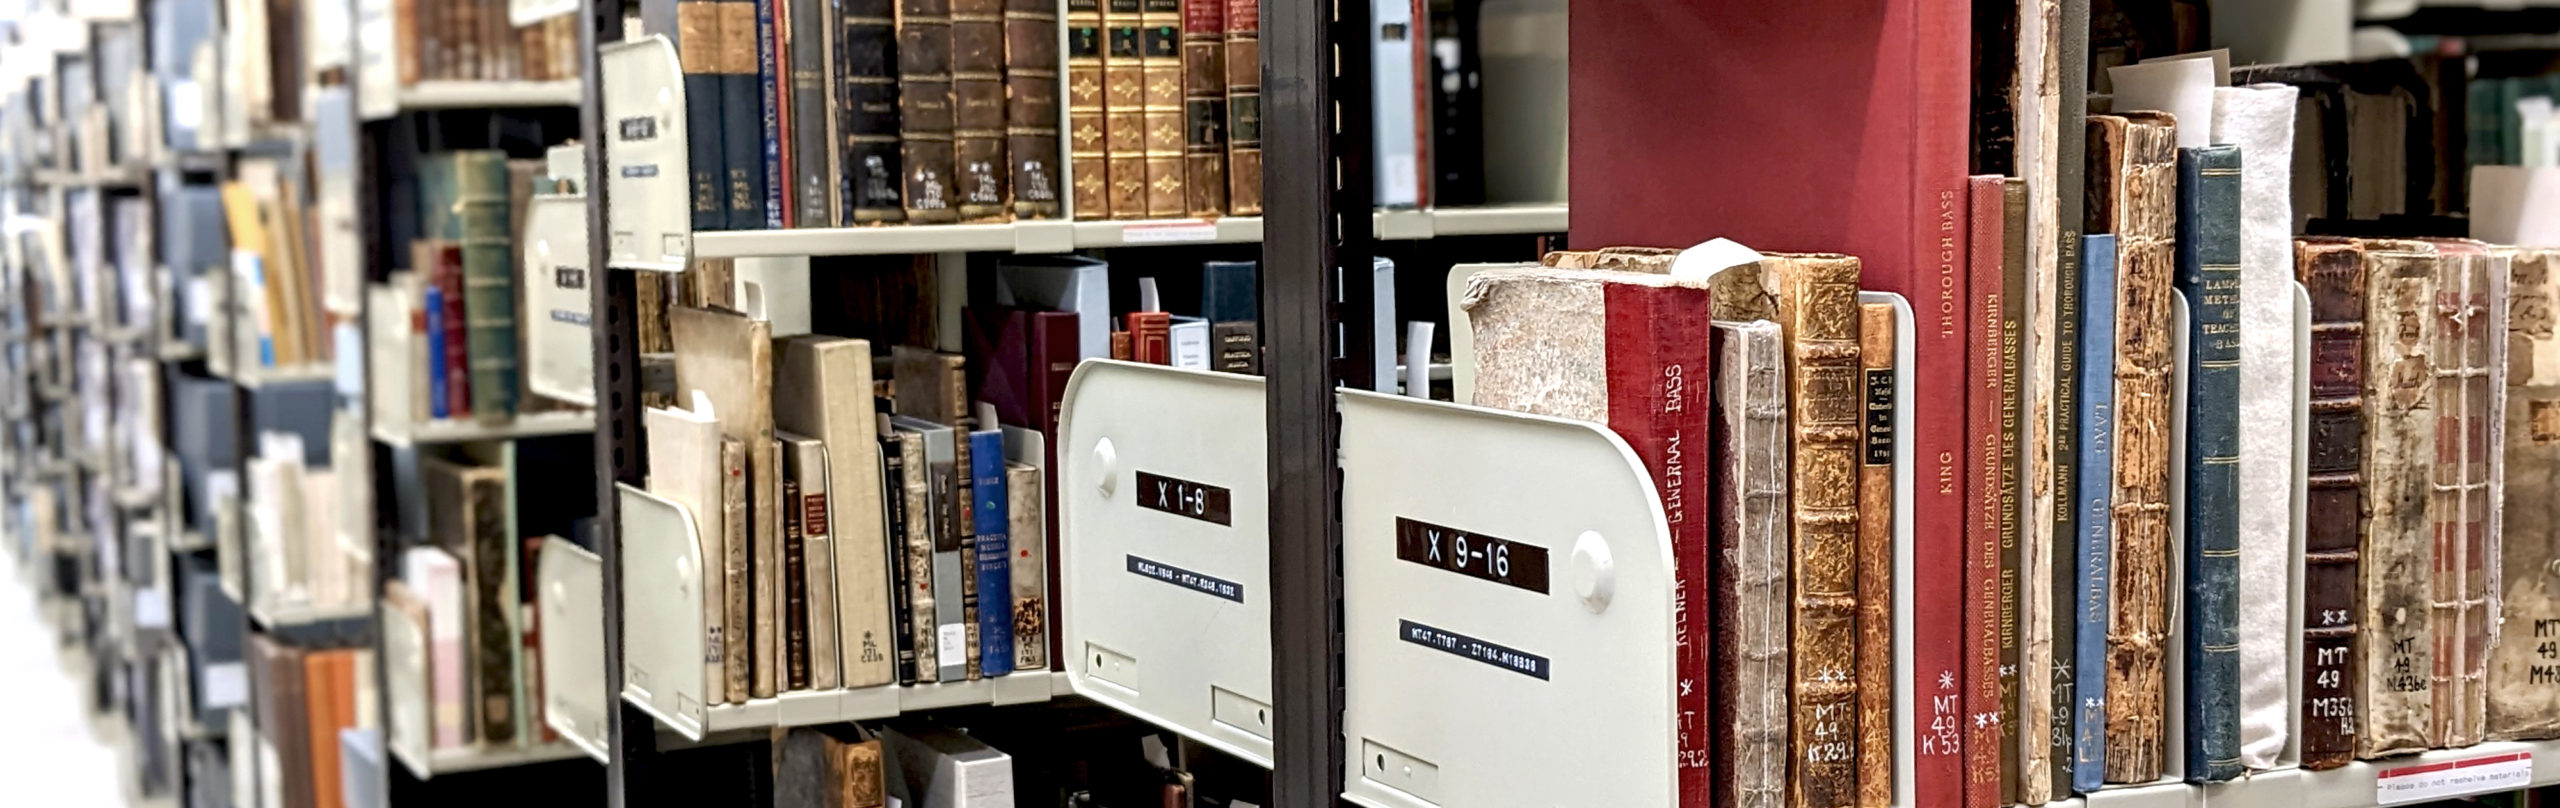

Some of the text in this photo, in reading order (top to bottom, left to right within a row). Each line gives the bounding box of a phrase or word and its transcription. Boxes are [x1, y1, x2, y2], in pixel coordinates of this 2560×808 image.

[1941, 190, 1954, 339] THOROUGH BASS
[2063, 262, 2076, 317] THOROUGH
[1986, 294, 1998, 389] KIRNBERGER
[2062, 321, 2074, 336] TO
[2061, 339, 2073, 371] GUIDE
[1665, 363, 1682, 414] BASS
[2059, 376, 2072, 431] PRACTICAL
[1939, 451, 1953, 496] KING
[2000, 320, 2017, 649] KIRNBERGER GRUNDSÄTZE DES GENERALBASSES
[1157, 480, 1205, 515] X 1-8
[2057, 464, 2069, 522] KOLLMANN
[1428, 529, 1509, 577] X 9-16
[1984, 541, 1995, 568] DES
[1984, 579, 1996, 699] GENERALBASSES
[2534, 618, 2560, 638] MT
[2317, 646, 2349, 667] MT
[2393, 636, 2416, 654] MT
[2537, 641, 2558, 659] 49
[2394, 657, 2411, 673] 49
[2316, 670, 2340, 689] 49
[1815, 703, 1848, 721] MT
[1934, 695, 1959, 715] MT
[1815, 722, 1838, 741] 49
[1931, 716, 1956, 737] 49
[2418, 780, 2428, 789] do
[2431, 778, 2445, 786] not
